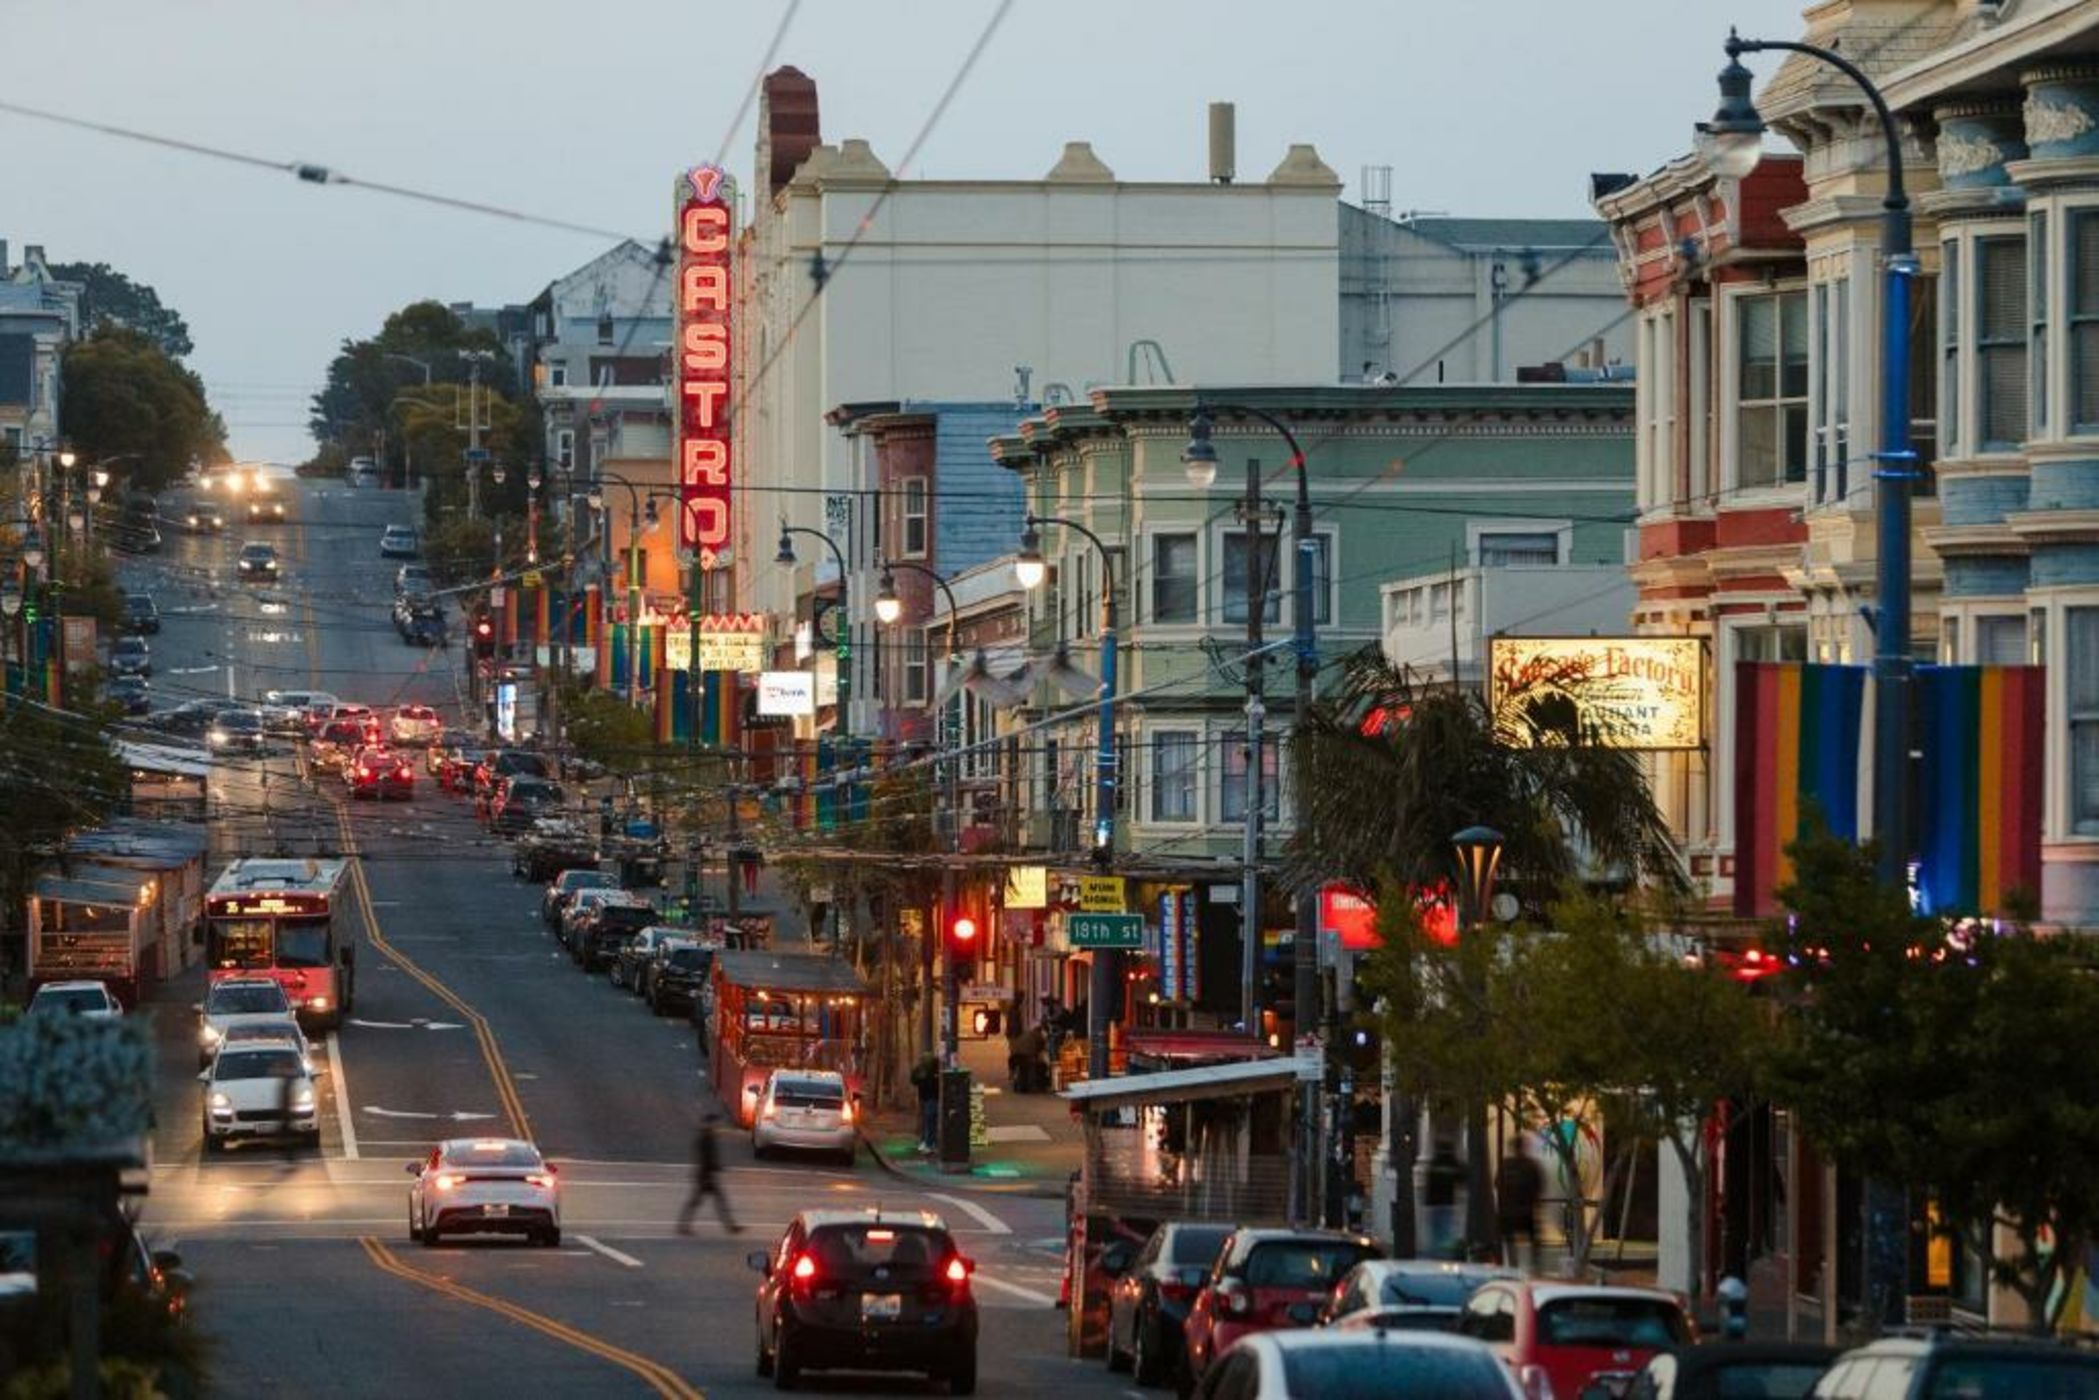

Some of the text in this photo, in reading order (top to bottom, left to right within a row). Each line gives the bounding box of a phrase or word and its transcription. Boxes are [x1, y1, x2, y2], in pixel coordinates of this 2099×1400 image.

[684, 207, 728, 543] CASTRO
[1606, 647, 1693, 693] Factory
[1074, 921, 1110, 940] 18th
